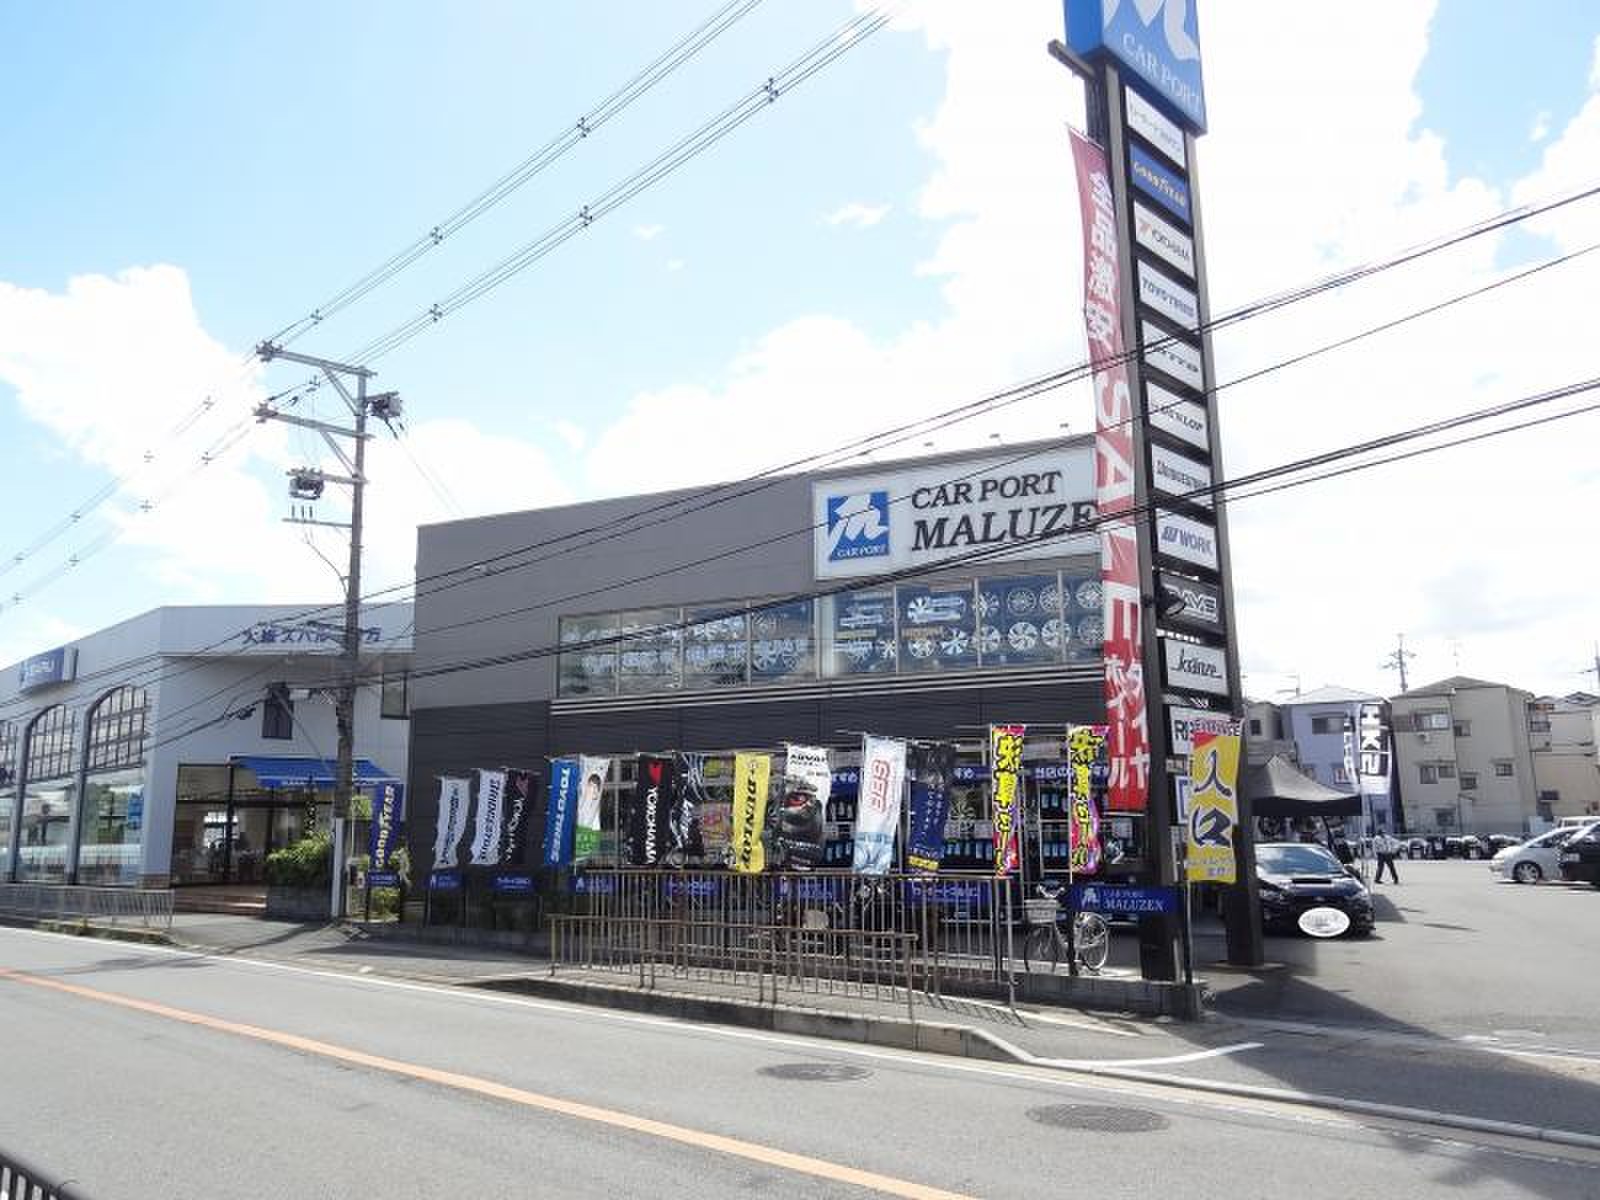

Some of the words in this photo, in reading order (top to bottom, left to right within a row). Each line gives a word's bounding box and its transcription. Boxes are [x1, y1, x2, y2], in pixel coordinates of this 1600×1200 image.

[1122, 32, 1157, 77] CAR
[1160, 68, 1202, 108] PORT
[910, 499, 1098, 553] MALUZE
[911, 480, 972, 511] CAR
[980, 470, 1062, 502] PORT
[1179, 528, 1214, 557] WORK
[1105, 653, 1131, 790] ホイール
[374, 784, 396, 872] GOODYEAR
[645, 785, 659, 864] YOKOHAMA
